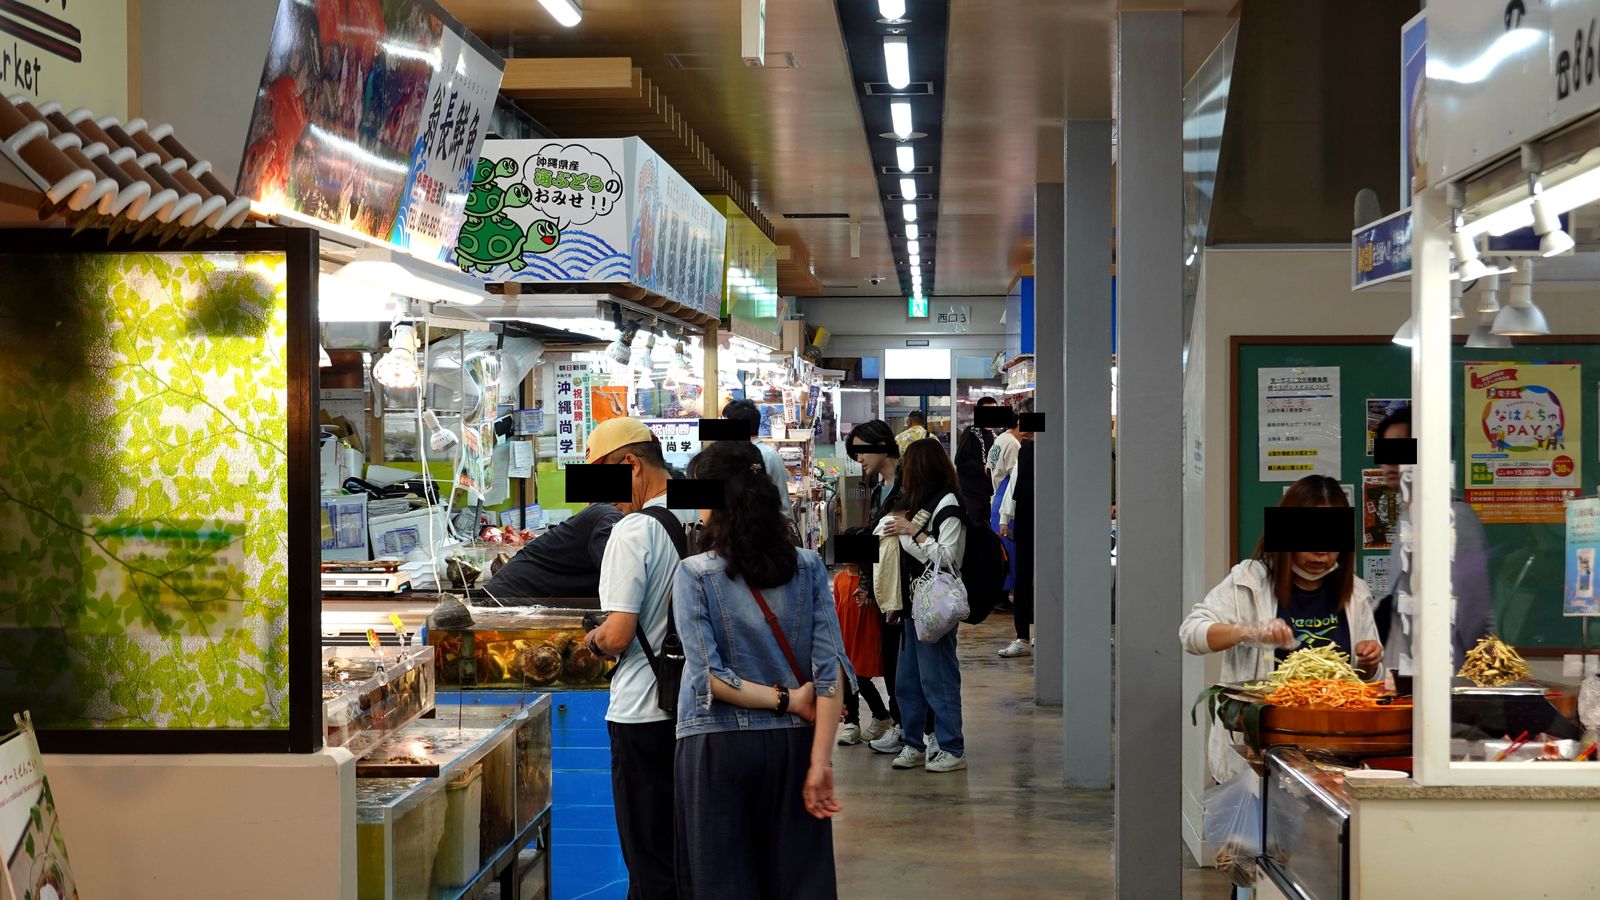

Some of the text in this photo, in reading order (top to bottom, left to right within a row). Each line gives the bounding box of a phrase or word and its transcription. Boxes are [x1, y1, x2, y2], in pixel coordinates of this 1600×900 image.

[0, 42, 41, 96] rket
[1572, 17, 1600, 92] 86
[424, 82, 481, 171] 翁長鮮魚
[536, 156, 580, 171] 沖縄県産
[533, 167, 620, 194] 海ぶどうの
[557, 380, 573, 454] 沖縄尚学
[573, 388, 583, 421] 祝優勝
[1494, 408, 1557, 422] なはんちゅ
[1507, 424, 1541, 436] PAY
